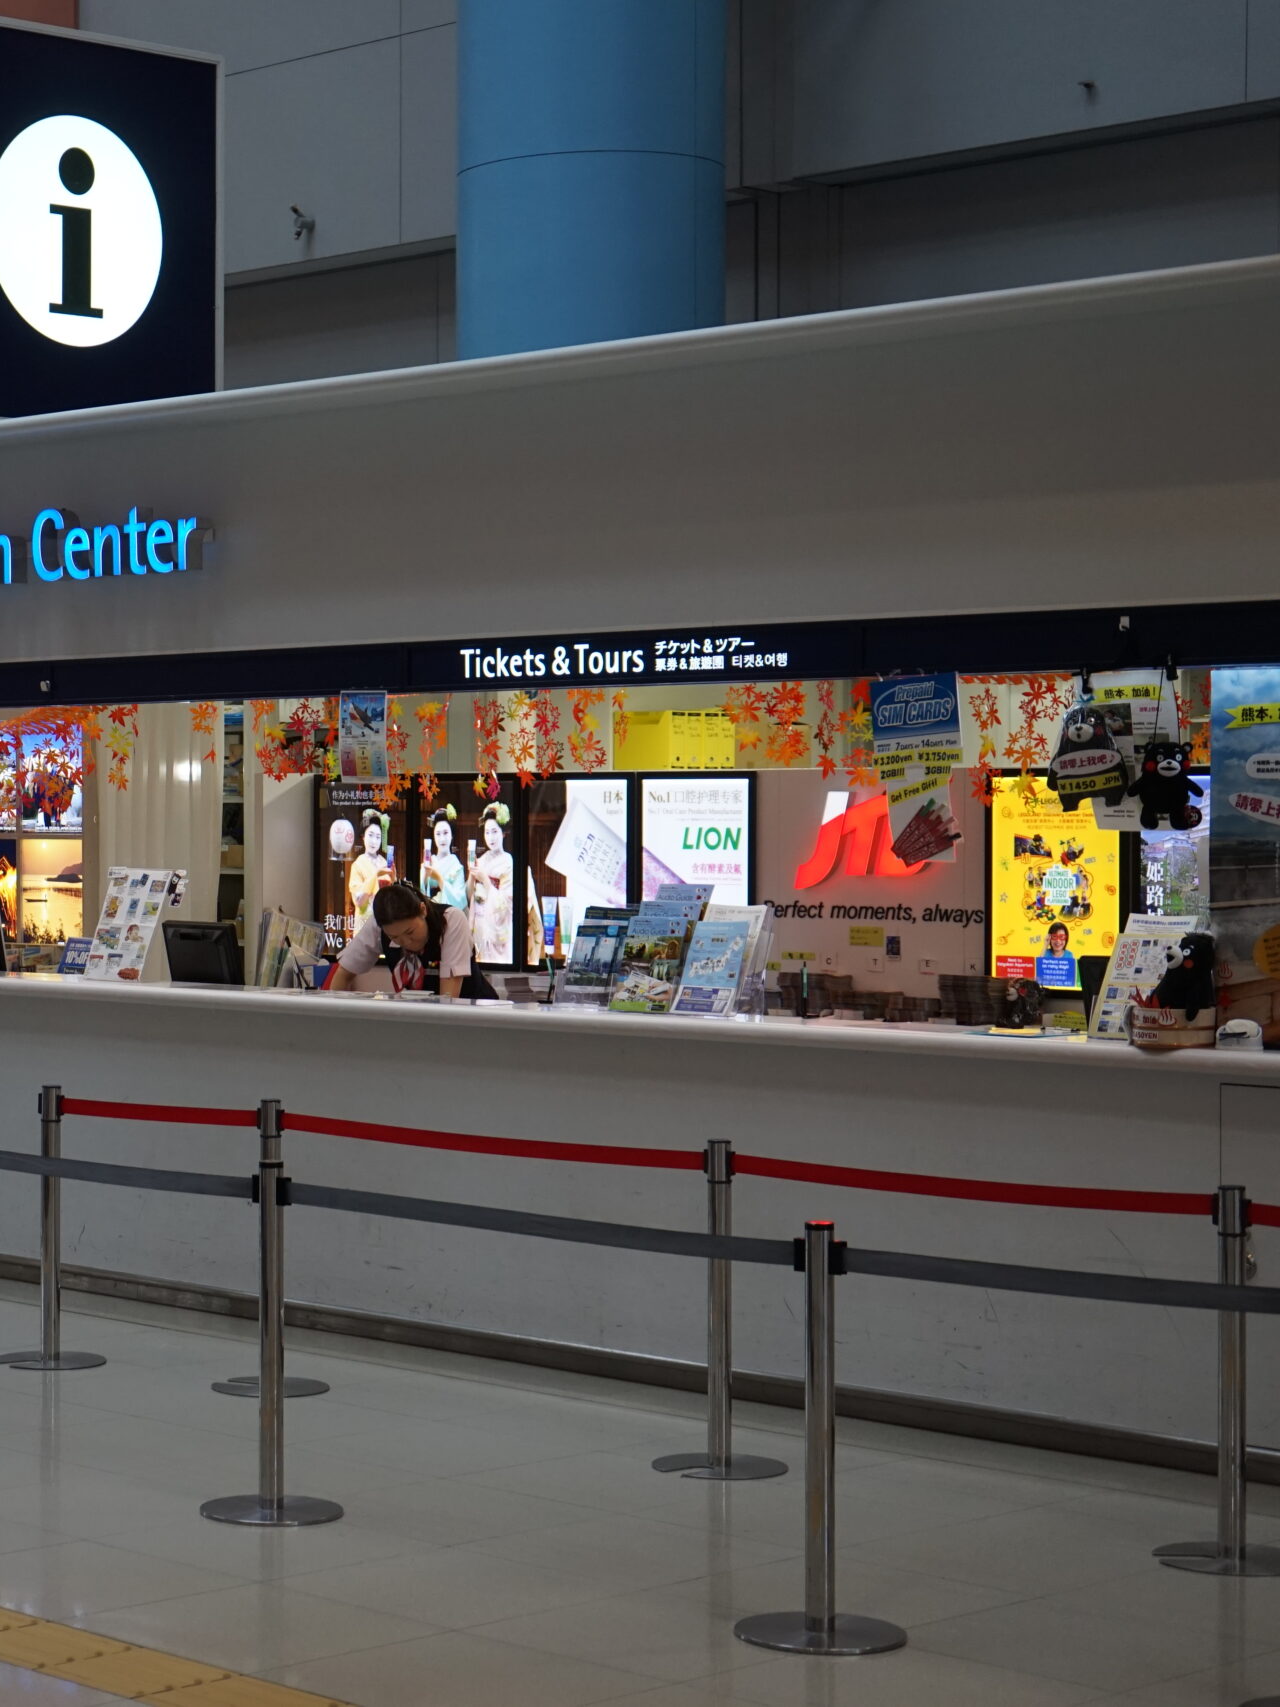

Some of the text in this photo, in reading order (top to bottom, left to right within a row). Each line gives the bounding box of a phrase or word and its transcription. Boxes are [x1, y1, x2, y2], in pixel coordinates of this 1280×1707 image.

[32, 507, 196, 581] Center
[459, 644, 645, 678] Tickets & Tours
[895, 682, 935, 701] Prepaid
[879, 698, 952, 727] SIM CARDS
[890, 791, 902, 803] Get
[903, 787, 920, 798] Free
[682, 827, 742, 850] LION
[1044, 877, 1074, 889] INDOOR
[1052, 890, 1067, 898] LEGO
[830, 902, 918, 924] moments,
[922, 903, 985, 928] always
[325, 933, 343, 948] We
